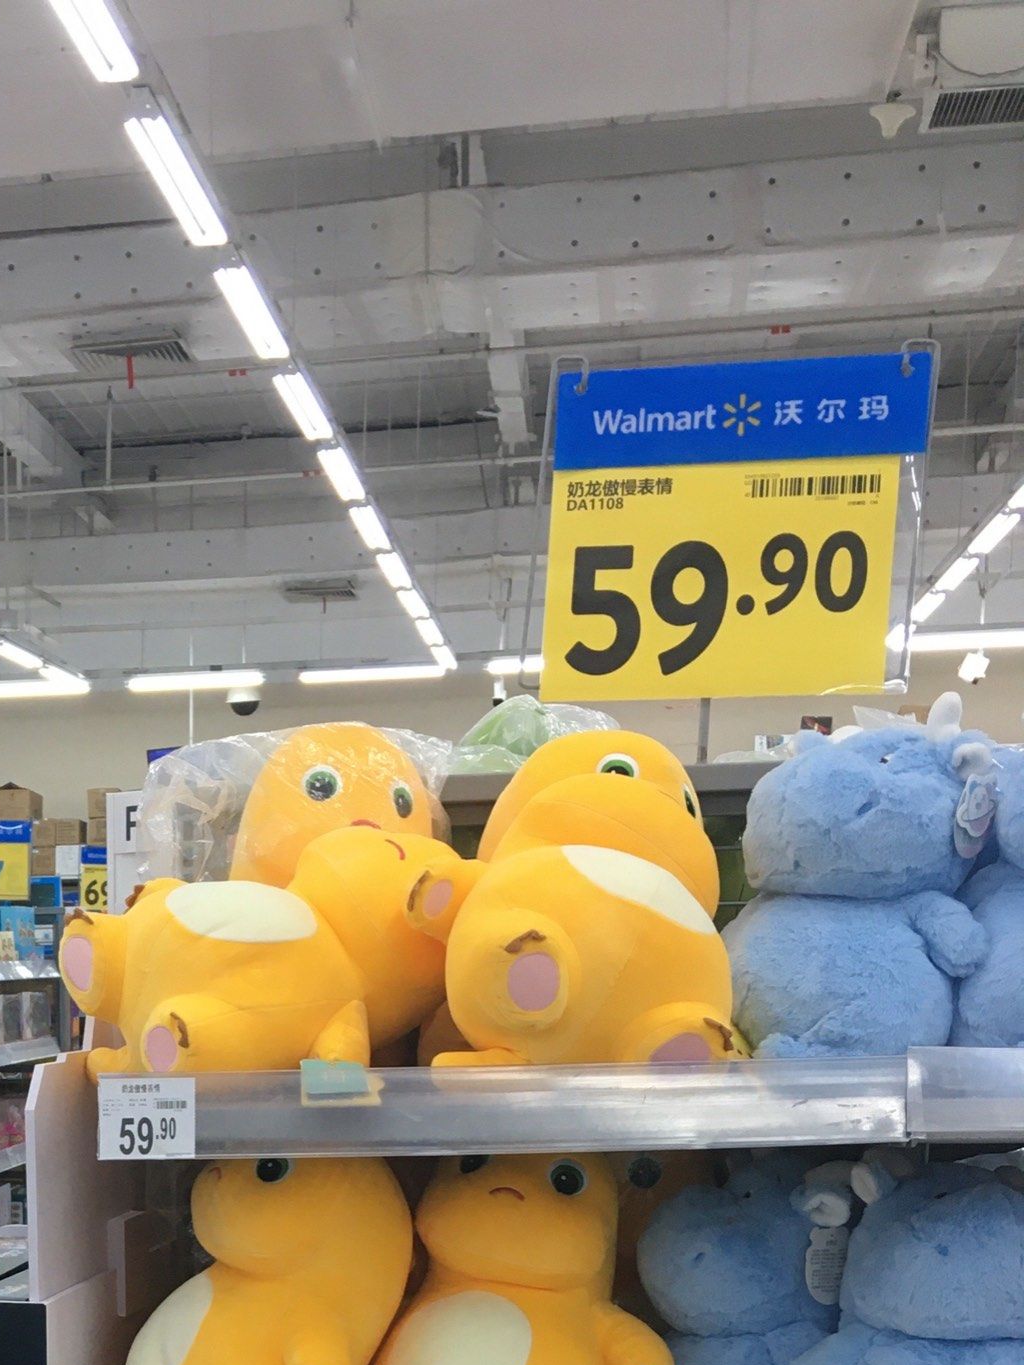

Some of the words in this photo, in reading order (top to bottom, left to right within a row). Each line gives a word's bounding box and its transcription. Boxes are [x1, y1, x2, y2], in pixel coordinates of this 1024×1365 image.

[593, 404, 717, 435] Walmart
[774, 395, 890, 426] 沃尔玛
[567, 477, 673, 498] 奶龙傲慢表情
[566, 497, 624, 511] DA1108
[564, 530, 868, 676] 59.90
[119, 1116, 176, 1155] 59.90
